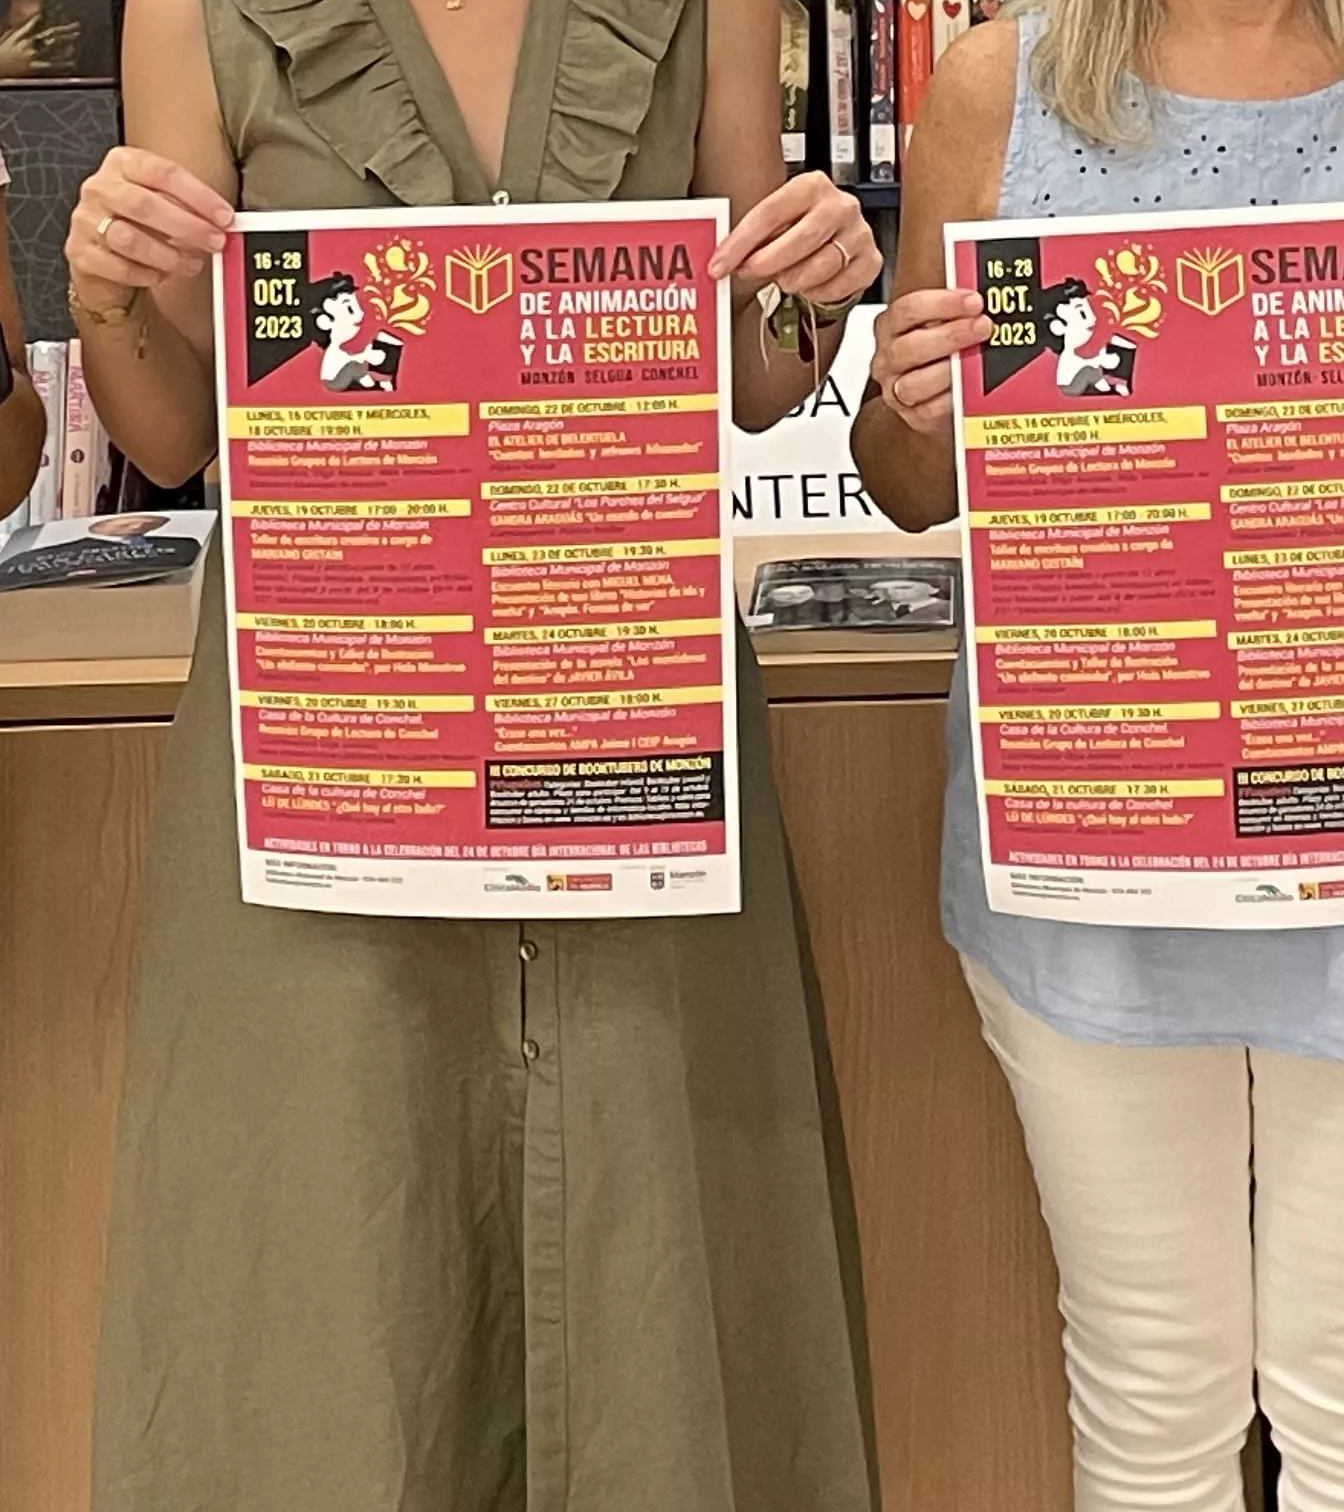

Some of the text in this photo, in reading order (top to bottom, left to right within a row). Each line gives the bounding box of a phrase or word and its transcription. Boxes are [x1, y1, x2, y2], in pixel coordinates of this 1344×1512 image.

[254, 252, 272, 270] 16
[283, 251, 302, 269] 28
[520, 244, 693, 284] SEMANA
[987, 260, 1004, 279] 16
[254, 278, 301, 306] OCT.
[520, 282, 697, 316] DE ANIMACIÓN
[987, 284, 1034, 314] OCT.
[1252, 291, 1285, 317] DE
[255, 316, 304, 340] 2023
[520, 313, 698, 341] A LA LECTURA
[988, 322, 1037, 347] 2023
[1254, 318, 1269, 342] A
[1279, 317, 1310, 341] LA
[520, 338, 701, 366] Y LA ESCRITURA
[1254, 344, 1269, 367] Y
[1280, 343, 1309, 367] LA
[521, 365, 699, 385] MONZÓN SELGUA CONCHEL
[1257, 370, 1313, 387] MONZÓN
[565, 547, 612, 559] OCTUBRE
[1063, 707, 1111, 720] OCTUBRE
